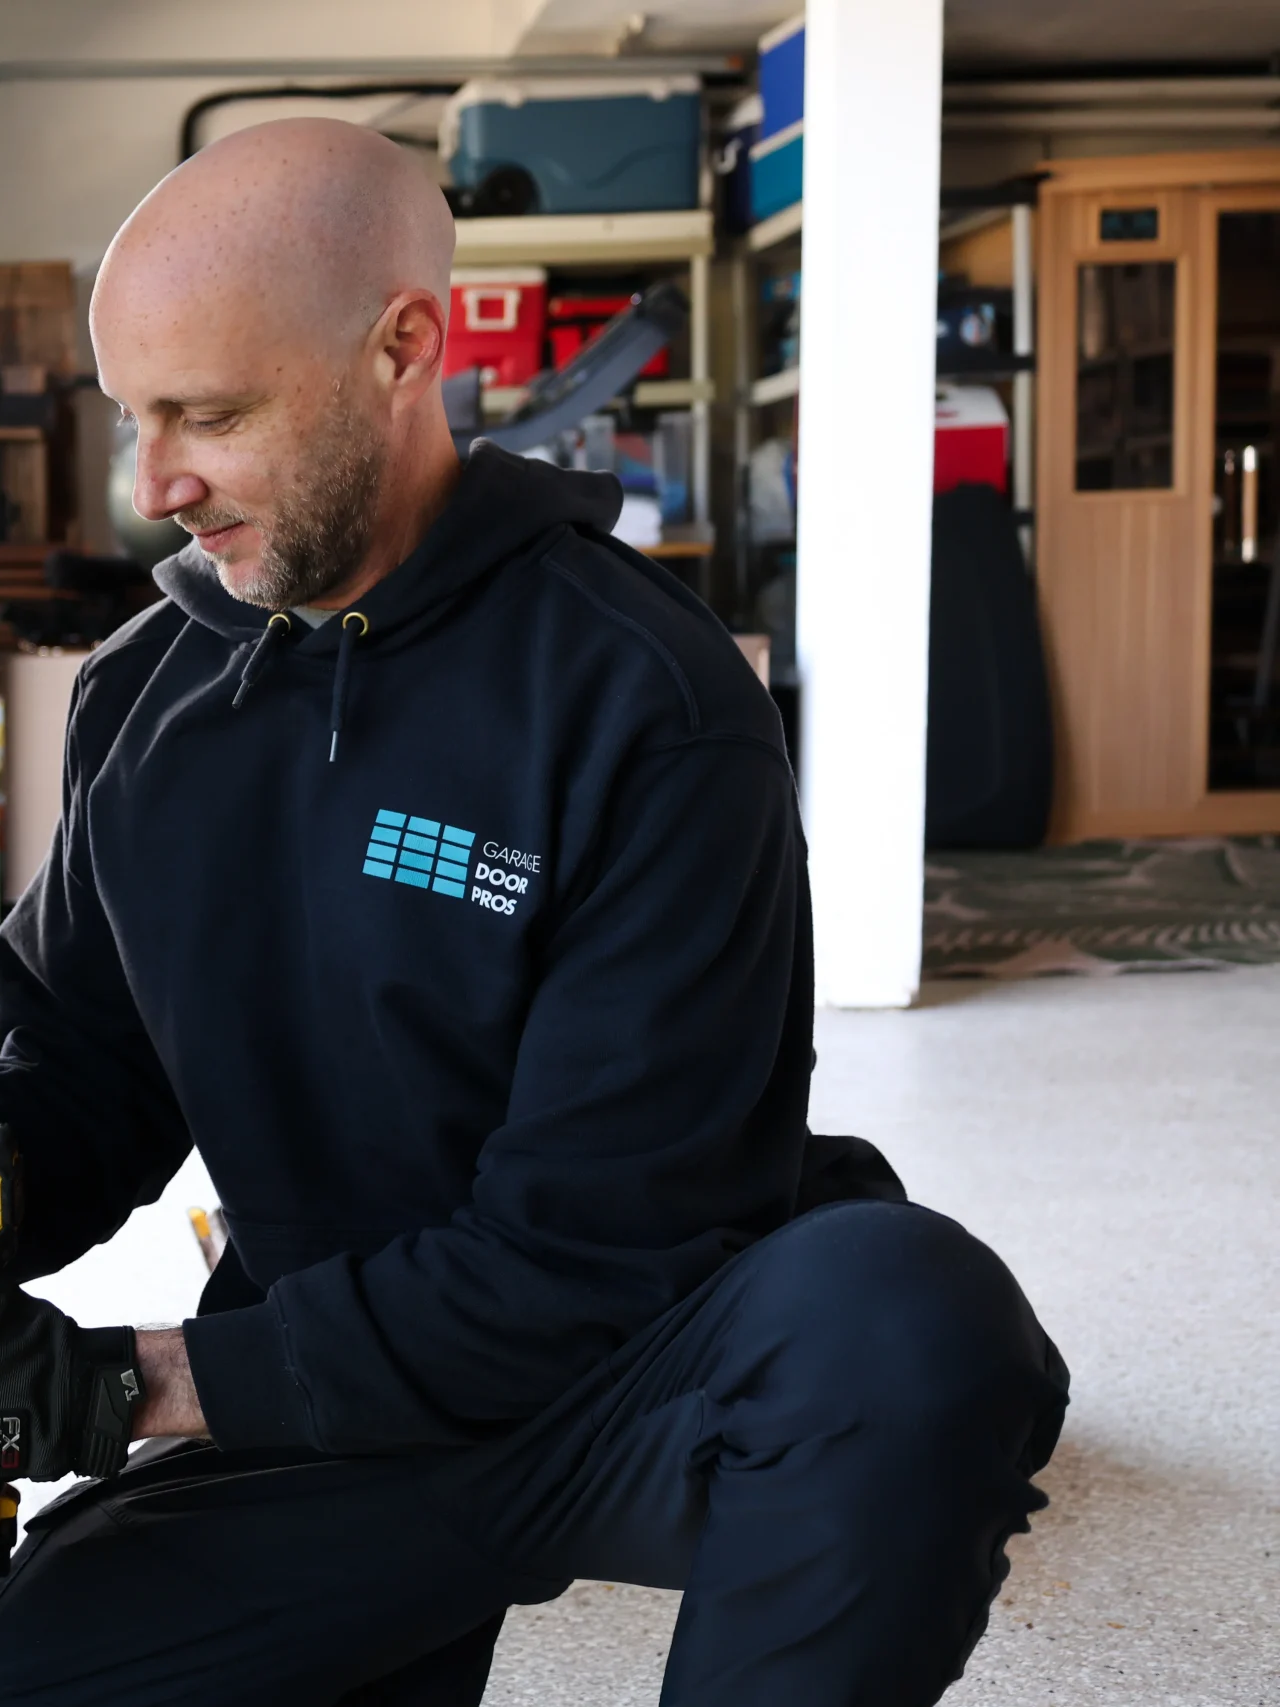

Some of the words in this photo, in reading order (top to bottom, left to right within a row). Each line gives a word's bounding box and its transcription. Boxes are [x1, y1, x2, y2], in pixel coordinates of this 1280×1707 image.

[483, 841, 542, 873] GARAGE
[475, 862, 529, 894] DOOR
[471, 885, 517, 915] PROS
[2, 1417, 20, 1468] FX3
